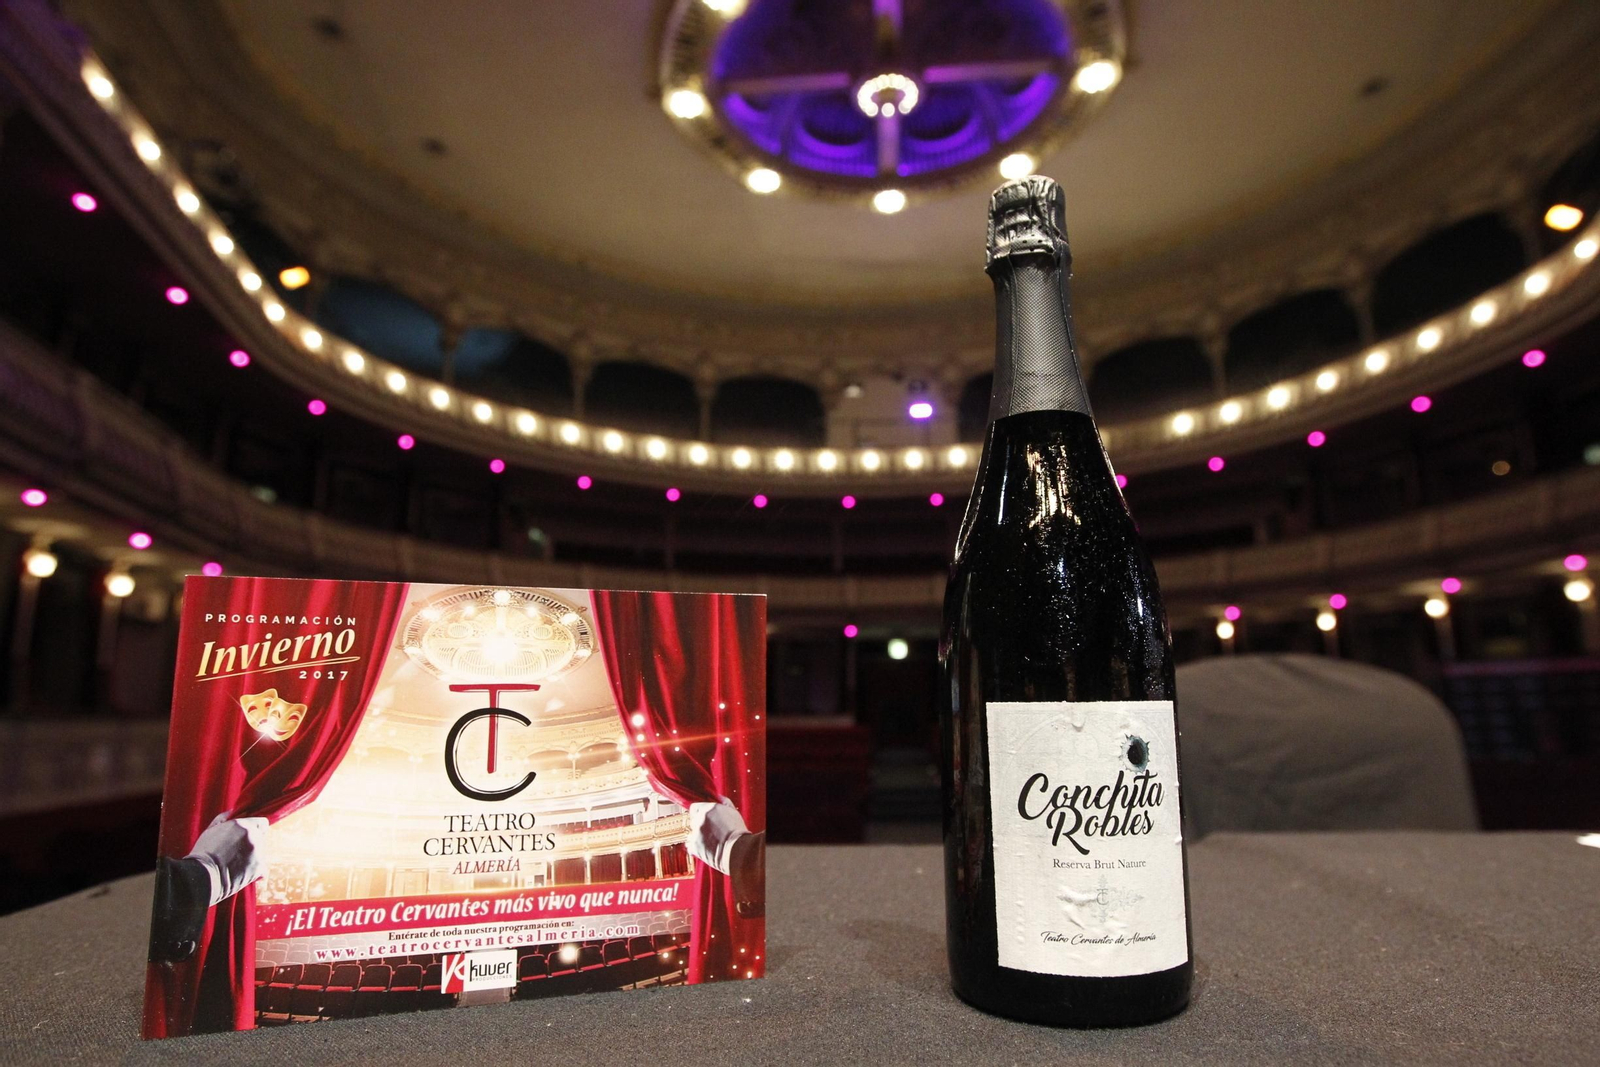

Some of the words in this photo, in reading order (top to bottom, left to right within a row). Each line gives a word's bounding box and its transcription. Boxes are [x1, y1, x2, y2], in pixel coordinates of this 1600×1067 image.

[205, 613, 356, 626] PROGRAMACIÓN
[195, 628, 356, 677] Invierno
[299, 670, 348, 681] 2017
[1017, 769, 1165, 820] Conchita
[444, 812, 536, 833] TEATRO
[1046, 805, 1155, 855] Robles
[423, 832, 556, 857] CERVANTES
[452, 856, 521, 875] ALMERÍA
[1053, 858, 1091, 869] Reserva
[1094, 859, 1115, 869] Brut
[1118, 859, 1147, 869] Nature
[285, 906, 316, 935] ¡El
[319, 905, 386, 929] Teatro
[390, 898, 490, 923] Cervantes
[494, 893, 533, 915] más
[537, 891, 576, 912] vivo
[579, 891, 614, 912] que
[617, 883, 679, 905] nunca!
[388, 931, 428, 941] Entérate
[430, 929, 441, 937] de
[442, 927, 462, 937] toda
[464, 925, 497, 935] nuestra
[499, 920, 560, 934] programación
[561, 920, 575, 928] en:
[1040, 930, 1070, 944] Teatro
[1071, 932, 1114, 945] Cervantes
[1114, 934, 1125, 944] de
[1124, 931, 1157, 946] Almería
[316, 924, 640, 961] www.teatrocervantesalmeria.com
[469, 959, 513, 982] kuver
